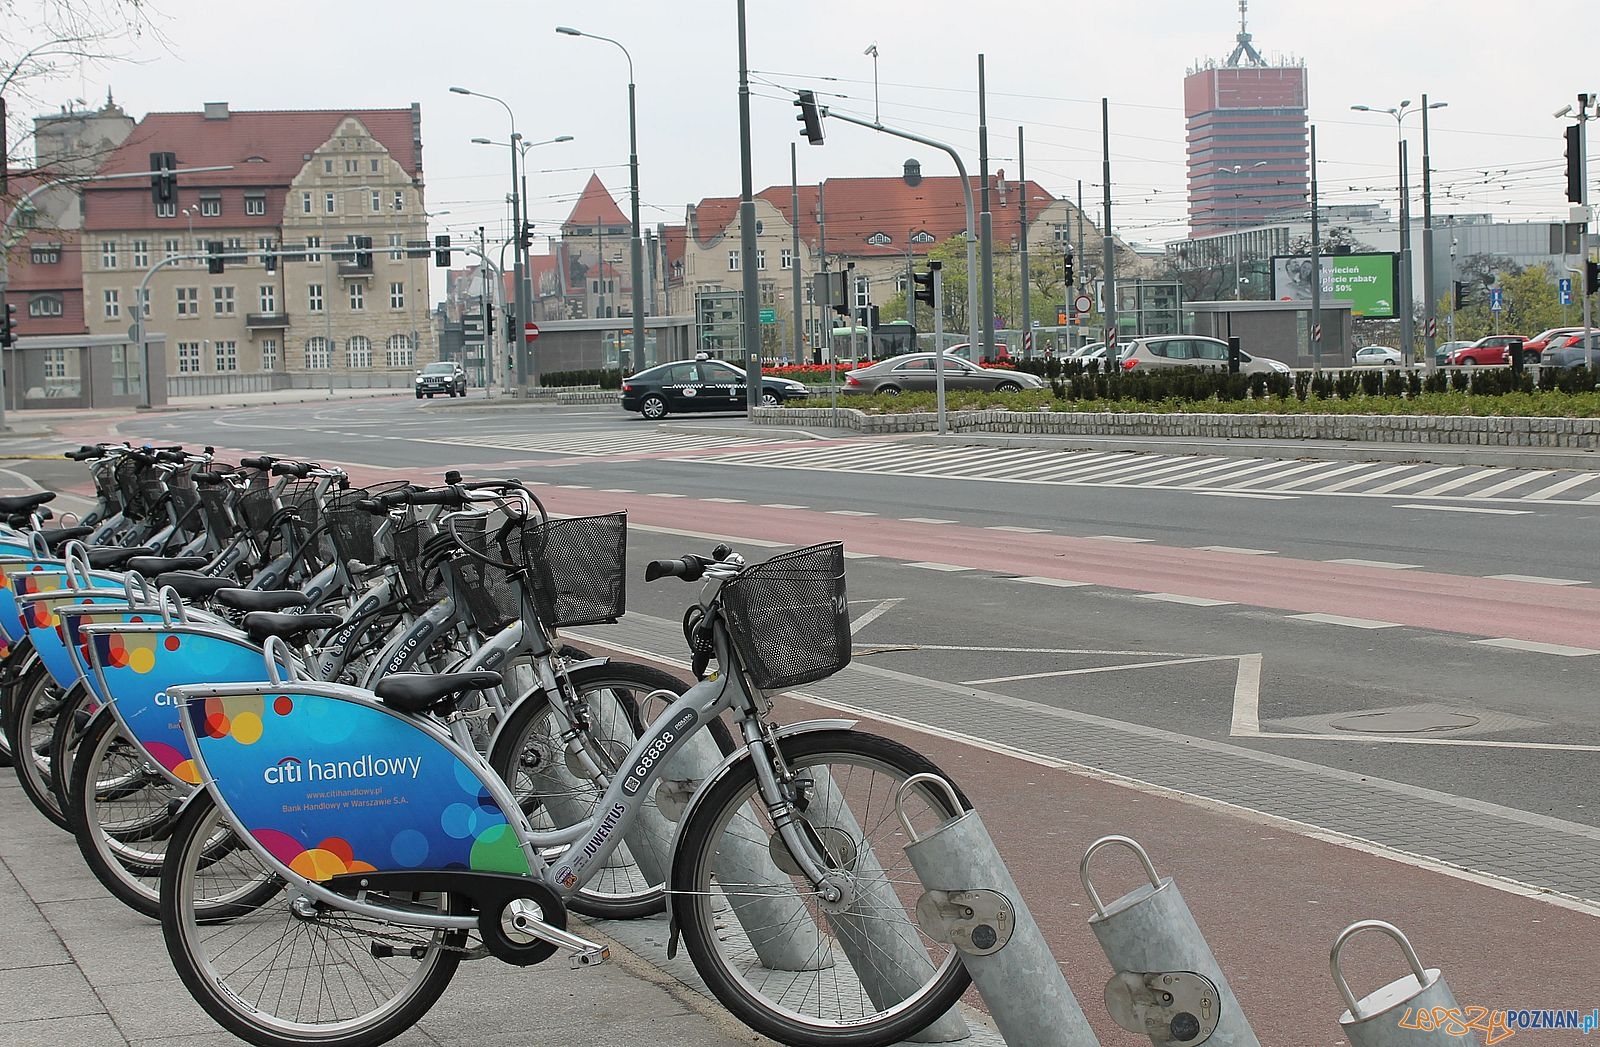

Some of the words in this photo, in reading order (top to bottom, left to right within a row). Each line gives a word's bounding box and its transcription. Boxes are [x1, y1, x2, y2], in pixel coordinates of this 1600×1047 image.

[1322, 265, 1360, 274] kwiecień
[1348, 275, 1378, 284] rabaty
[1335, 284, 1353, 292] 50%
[389, 638, 417, 672] 68616
[635, 731, 674, 777] 68888
[264, 758, 302, 784] citi
[308, 754, 422, 780] handlowy
[306, 787, 383, 799] www.citihandlowy.pl
[282, 804, 302, 813] Bank
[303, 800, 341, 811] Handlowy
[351, 798, 392, 808] Warszawie
[393, 797, 409, 805] S.A.
[582, 802, 626, 859] JUWENTUS
